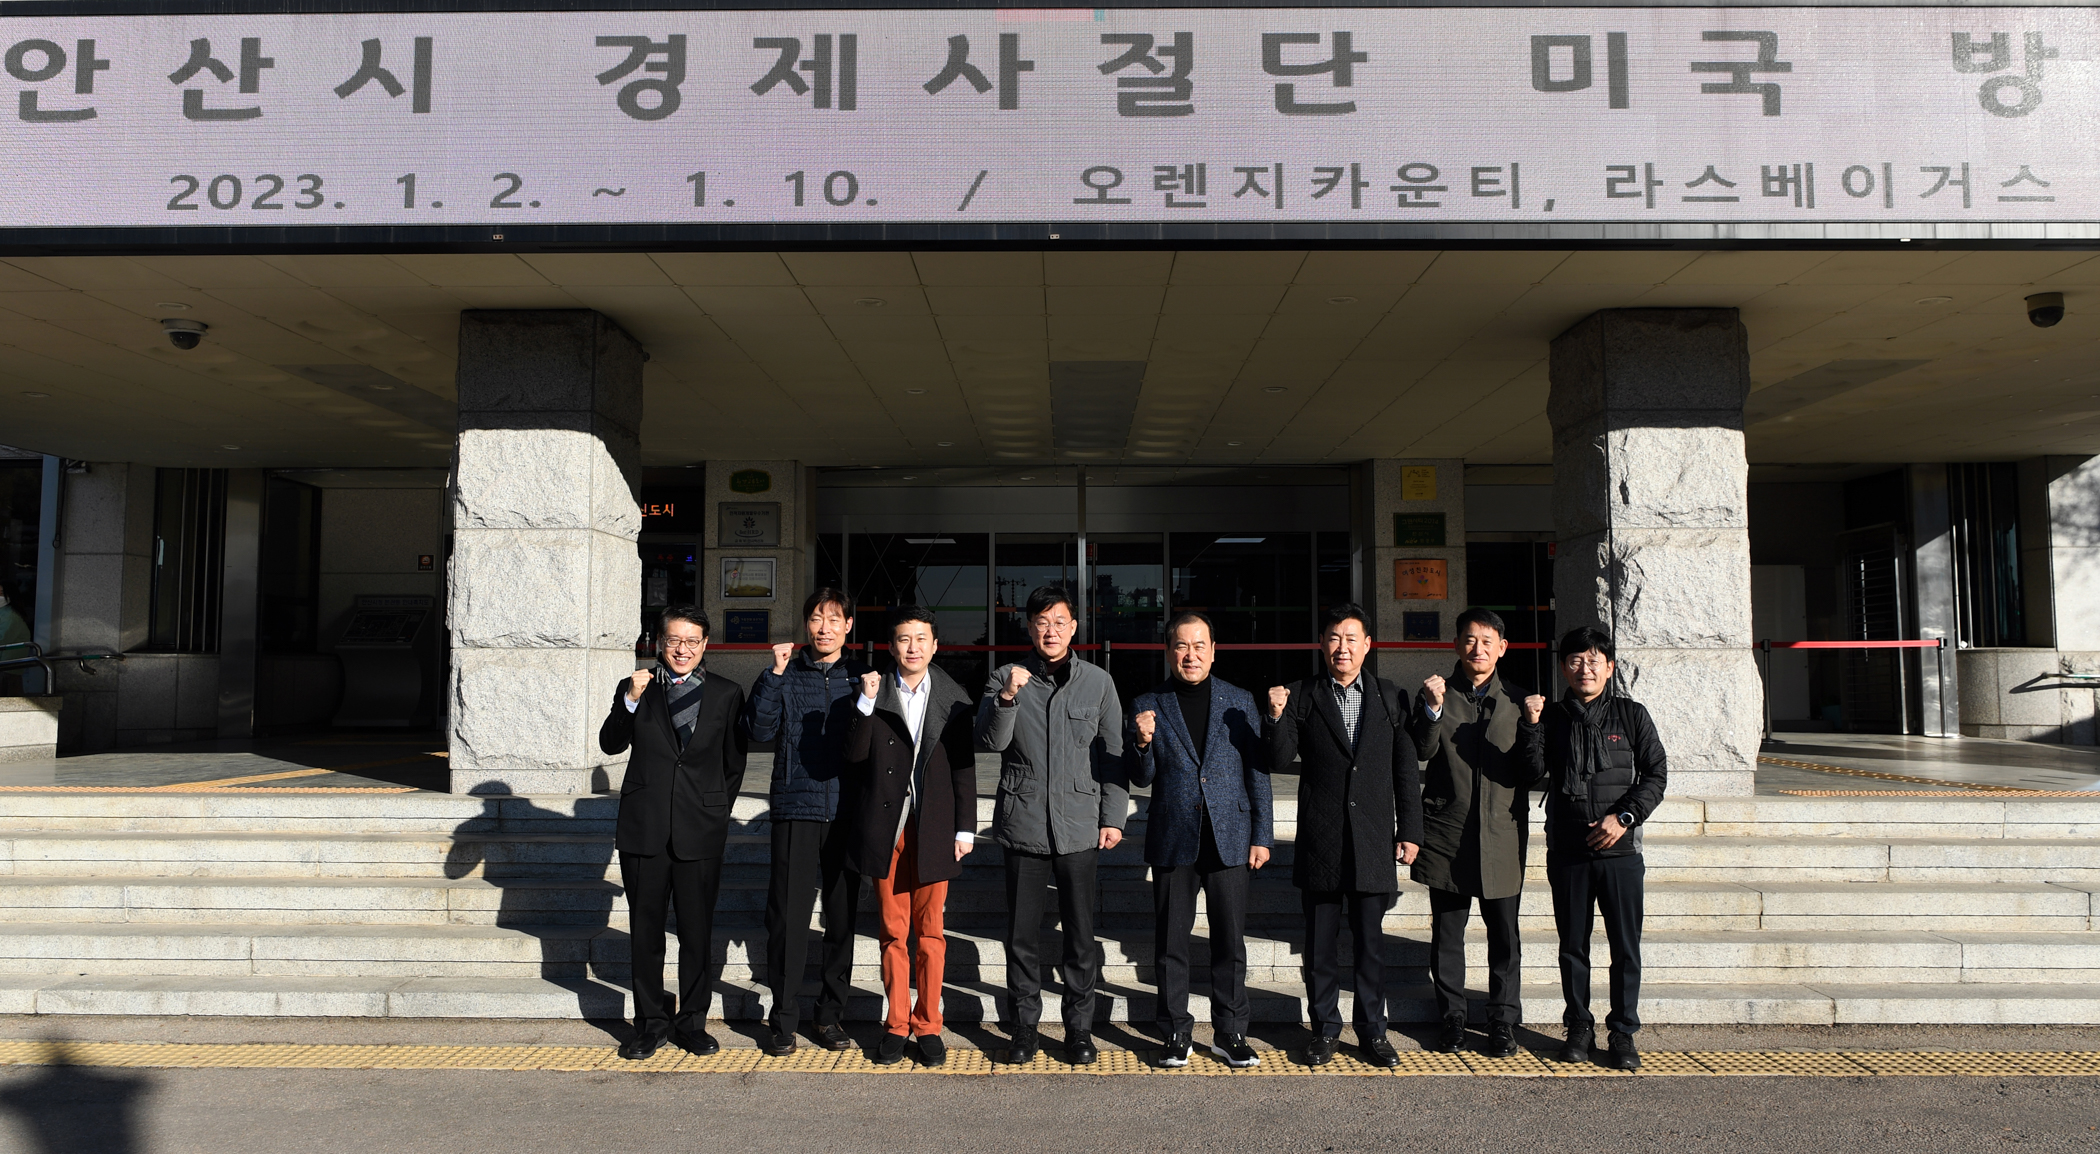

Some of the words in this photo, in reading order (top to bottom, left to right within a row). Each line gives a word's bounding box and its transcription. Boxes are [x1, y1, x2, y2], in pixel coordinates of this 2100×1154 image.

[4, 36, 433, 123] 안산시
[595, 31, 1367, 121] 경제사절단
[1531, 31, 1792, 116] 미국
[1951, 31, 2060, 118] 방
[167, 173, 346, 210] 2023.
[396, 172, 443, 209] 1.
[490, 172, 541, 209] 2.
[686, 171, 736, 208] 1.
[785, 170, 878, 208] 10.
[957, 169, 988, 211] /
[1073, 162, 1556, 212] 오렌지카운티,
[1606, 162, 2056, 210] 라스베이거스
